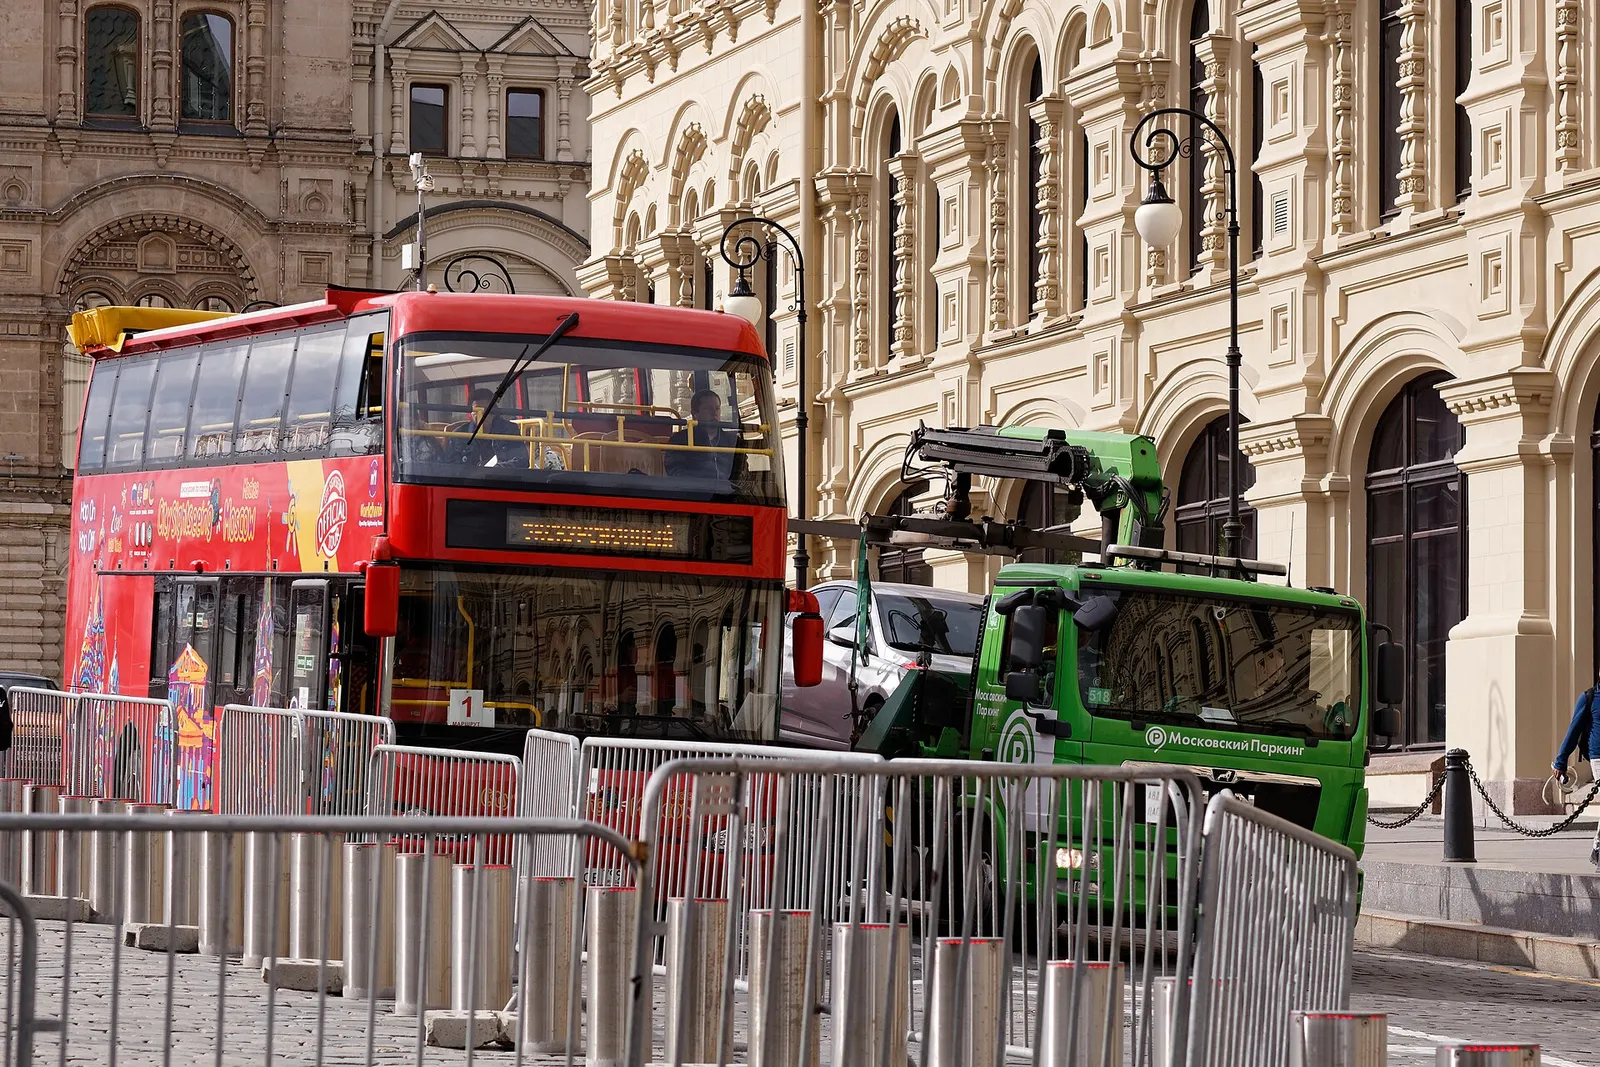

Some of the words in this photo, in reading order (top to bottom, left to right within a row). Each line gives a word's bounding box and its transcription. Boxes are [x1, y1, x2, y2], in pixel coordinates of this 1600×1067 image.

[80, 501, 89, 524] Hop
[89, 498, 96, 521] On
[223, 497, 257, 543] Moscow
[318, 501, 346, 543] OFFICIAL
[78, 530, 88, 554] Hop
[462, 696, 472, 718] 1
[1089, 690, 1110, 703] 518
[976, 703, 1000, 719] Паркинг
[1168, 731, 1249, 751] Московский
[1251, 739, 1305, 757] Паркинг
